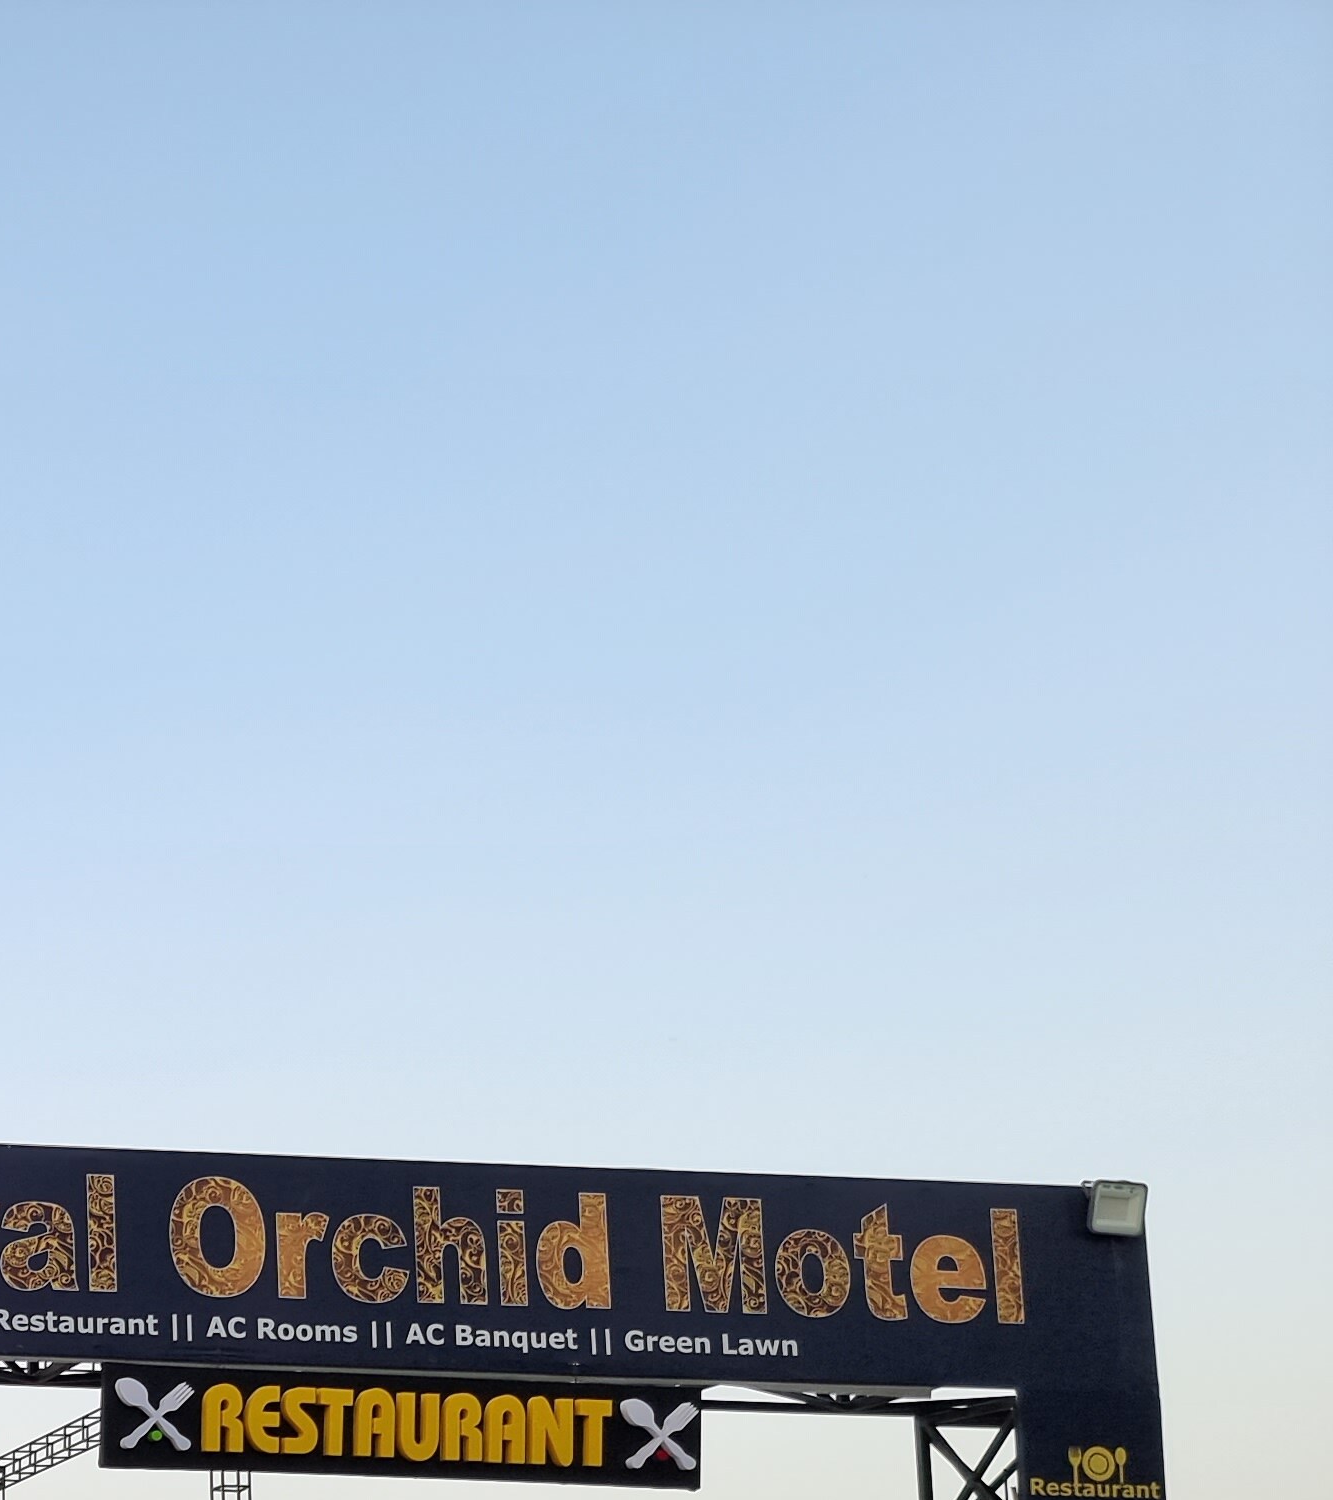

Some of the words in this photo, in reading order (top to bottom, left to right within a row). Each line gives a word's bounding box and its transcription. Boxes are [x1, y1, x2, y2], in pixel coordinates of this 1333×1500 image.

[168, 1176, 613, 1310] Orchid
[660, 1194, 1026, 1325] Motel
[206, 1316, 247, 1339] AC
[257, 1318, 358, 1343] Rooms
[405, 1323, 445, 1346] AC
[455, 1324, 578, 1354] Banquet
[624, 1329, 711, 1355] Green
[722, 1332, 799, 1357] Lawn
[201, 1382, 613, 1468] RESTAURANT
[1029, 1477, 1162, 1499] Restaurant
